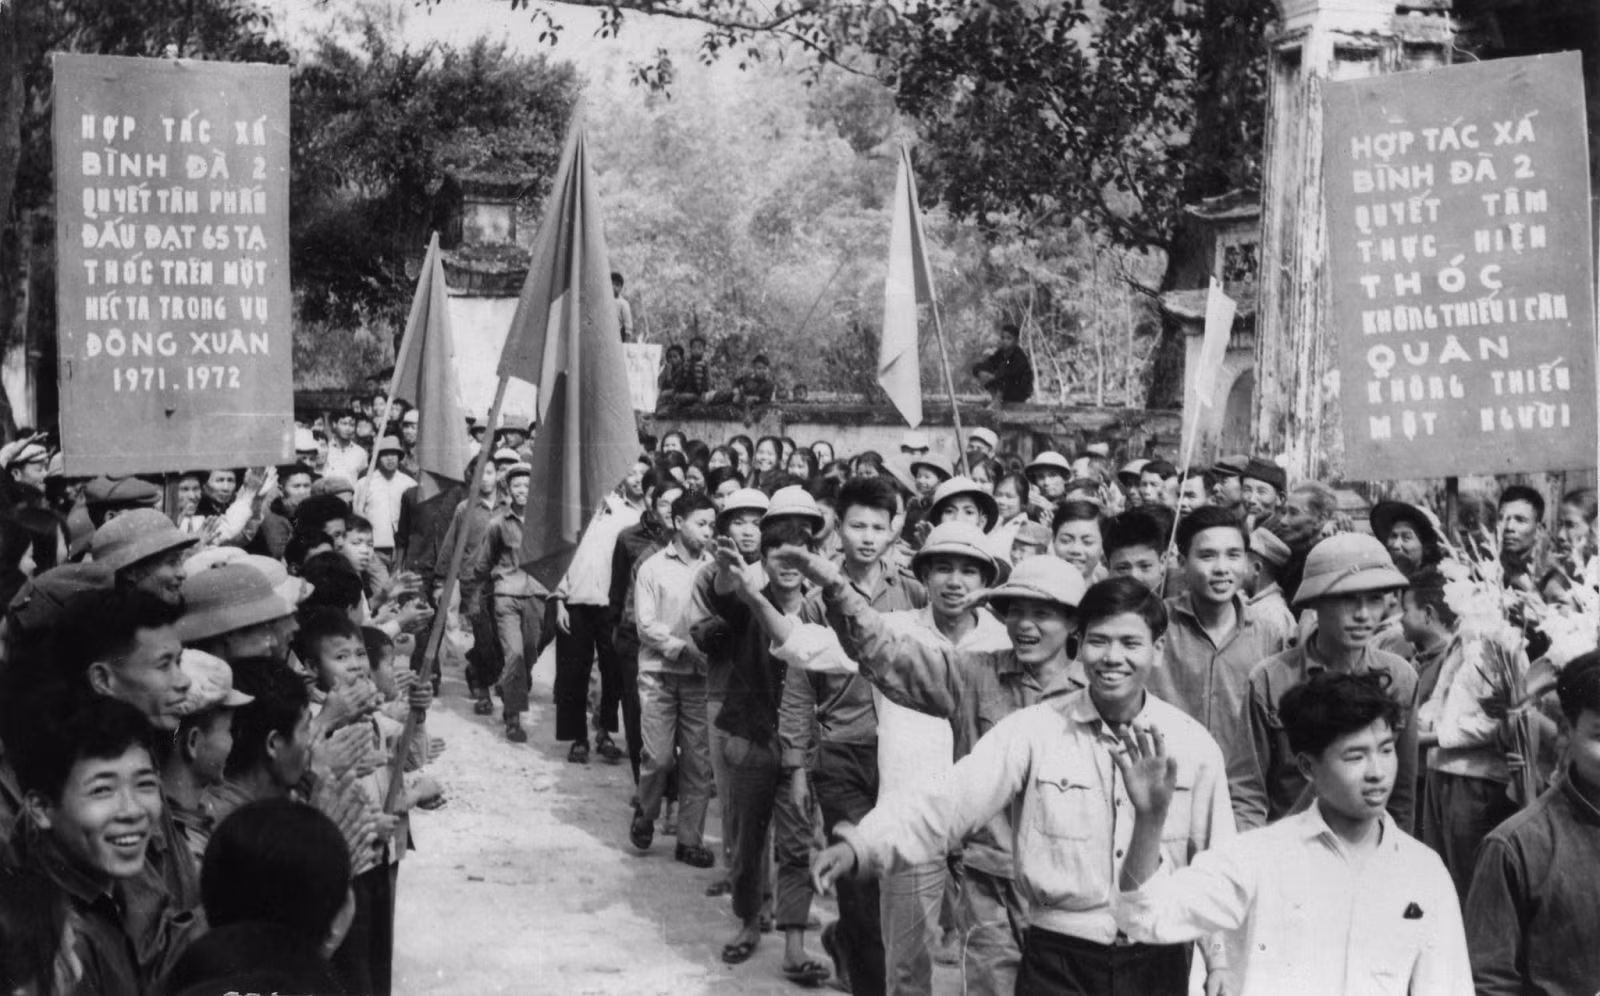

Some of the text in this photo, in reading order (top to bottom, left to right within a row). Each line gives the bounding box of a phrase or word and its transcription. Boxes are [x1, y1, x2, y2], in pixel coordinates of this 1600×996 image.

[82, 114, 135, 144] HỢP
[162, 109, 210, 144] TÁC
[1351, 130, 1415, 162] HỢP
[1421, 116, 1480, 152] TÁC
[82, 148, 267, 179] BÌNH ĐÀ 2
[1513, 154, 1536, 179] 2
[82, 182, 151, 220] QUYẾT
[1355, 187, 1548, 235] QUYẾT TÂM
[81, 216, 267, 252] ĐẤU ĐẠT 65 TẠ
[1360, 253, 1503, 299] THÓC
[159, 296, 227, 321] TRONG
[239, 296, 268, 325] VỤ
[86, 328, 269, 357] ĐÔNG XUÂN
